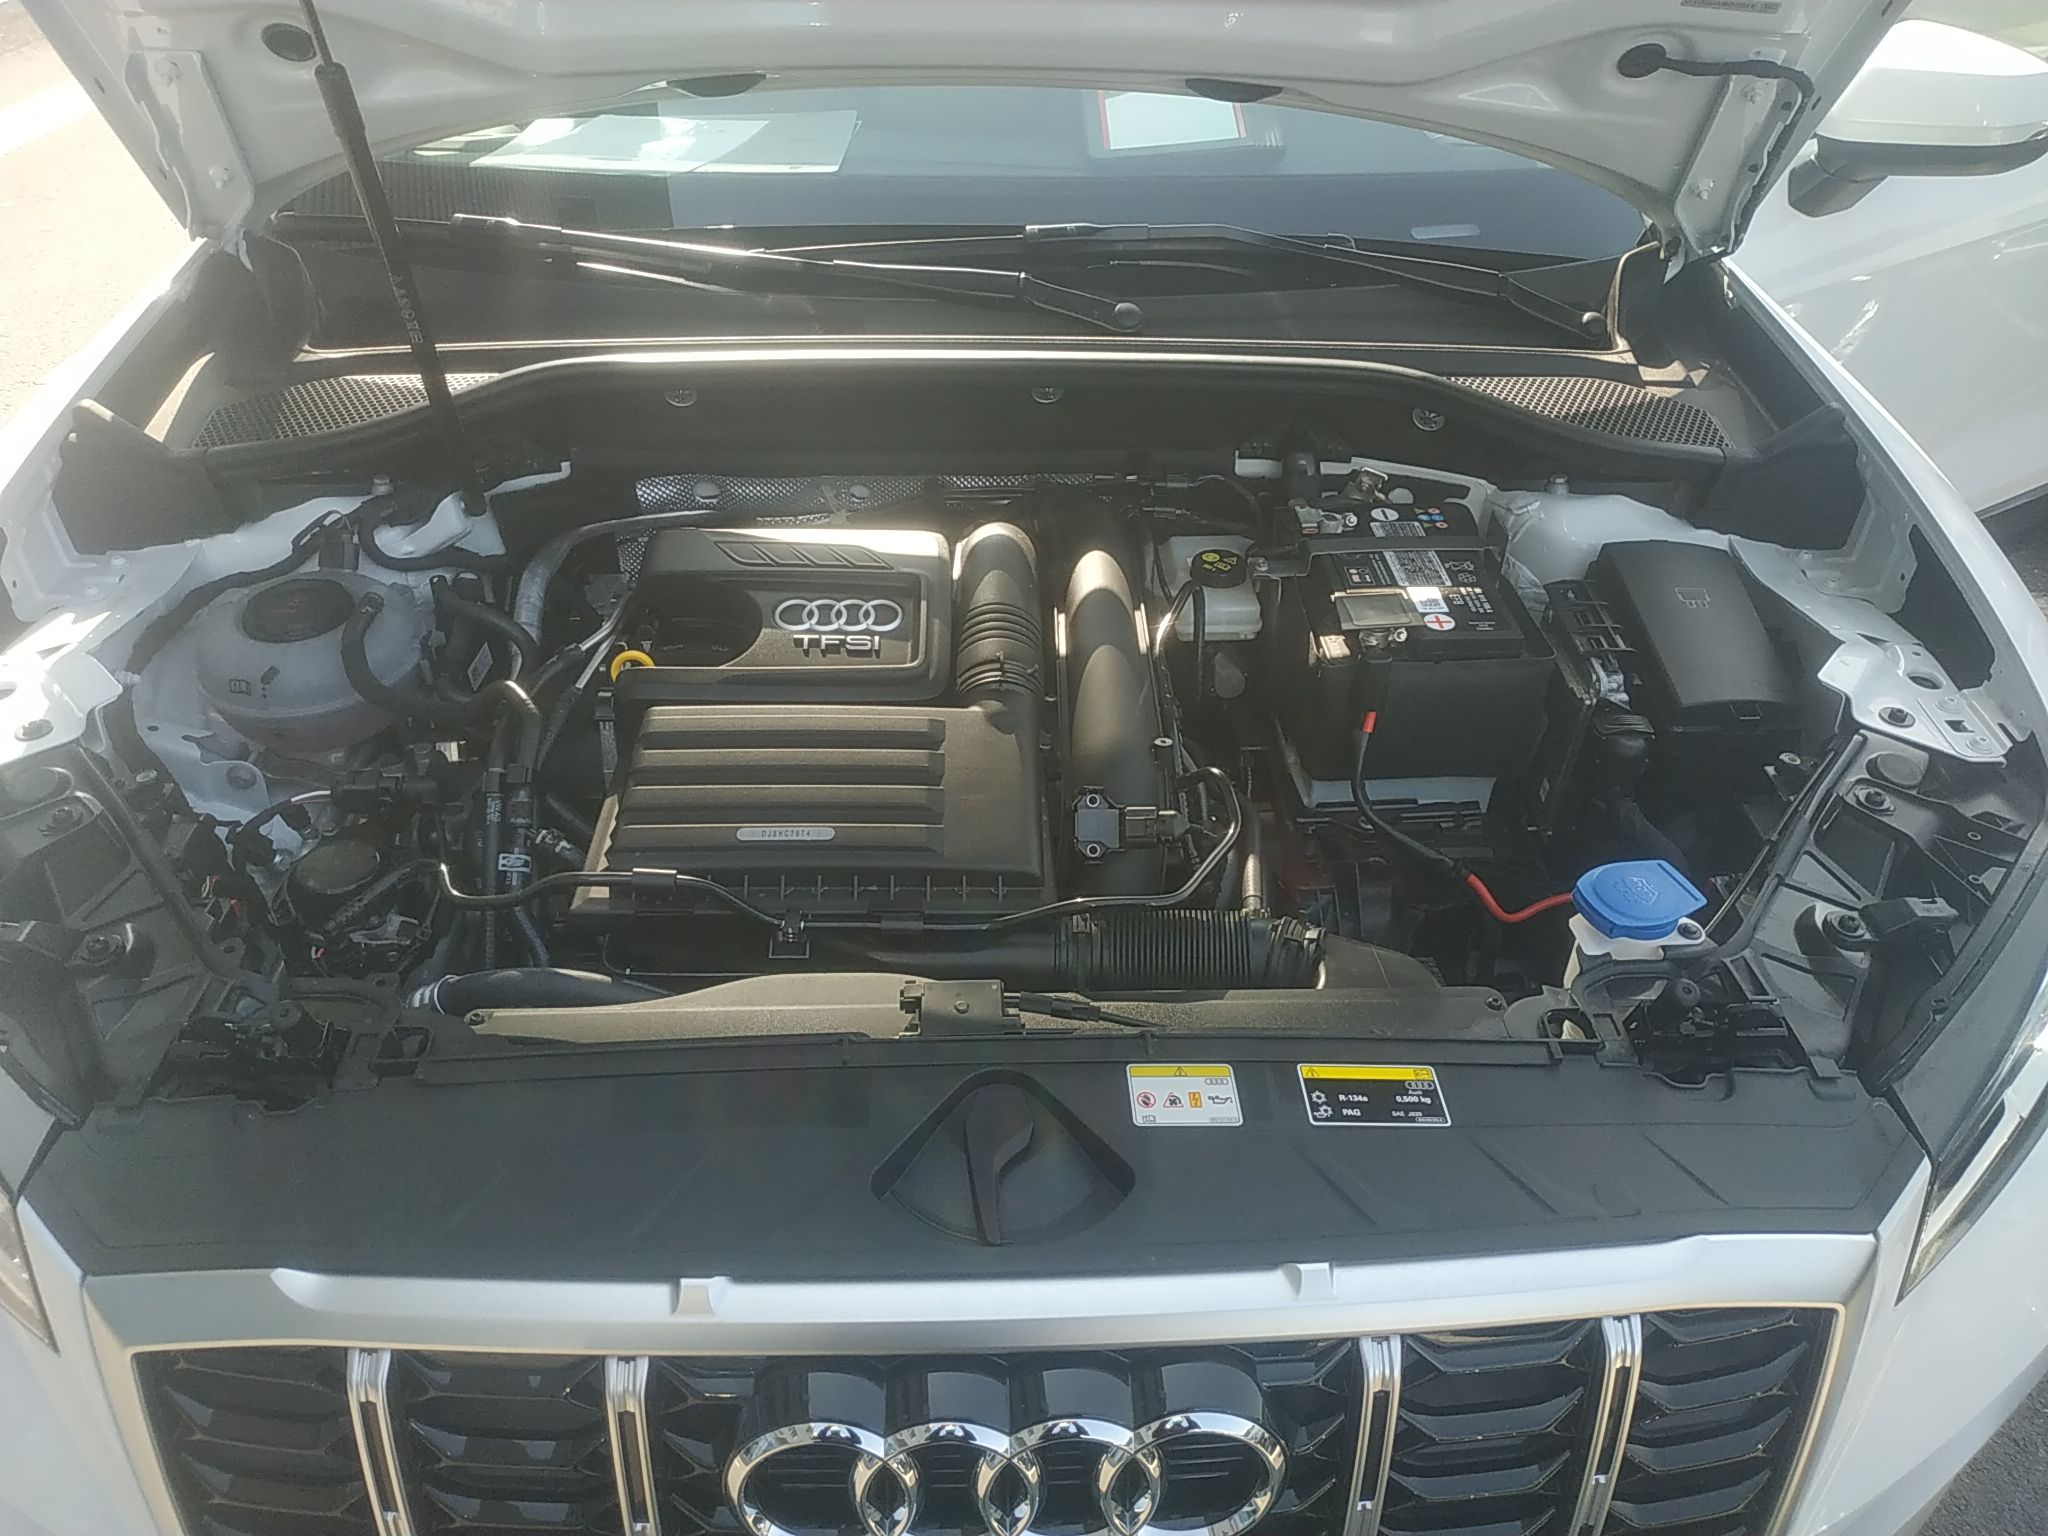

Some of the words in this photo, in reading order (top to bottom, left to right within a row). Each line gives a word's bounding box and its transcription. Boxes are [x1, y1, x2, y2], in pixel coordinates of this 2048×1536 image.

[793, 634, 880, 650] TFSI
[1338, 1094, 1369, 1102] R-134a
[1419, 1095, 1432, 1104] kg
[1341, 1108, 1362, 1116] PAG
